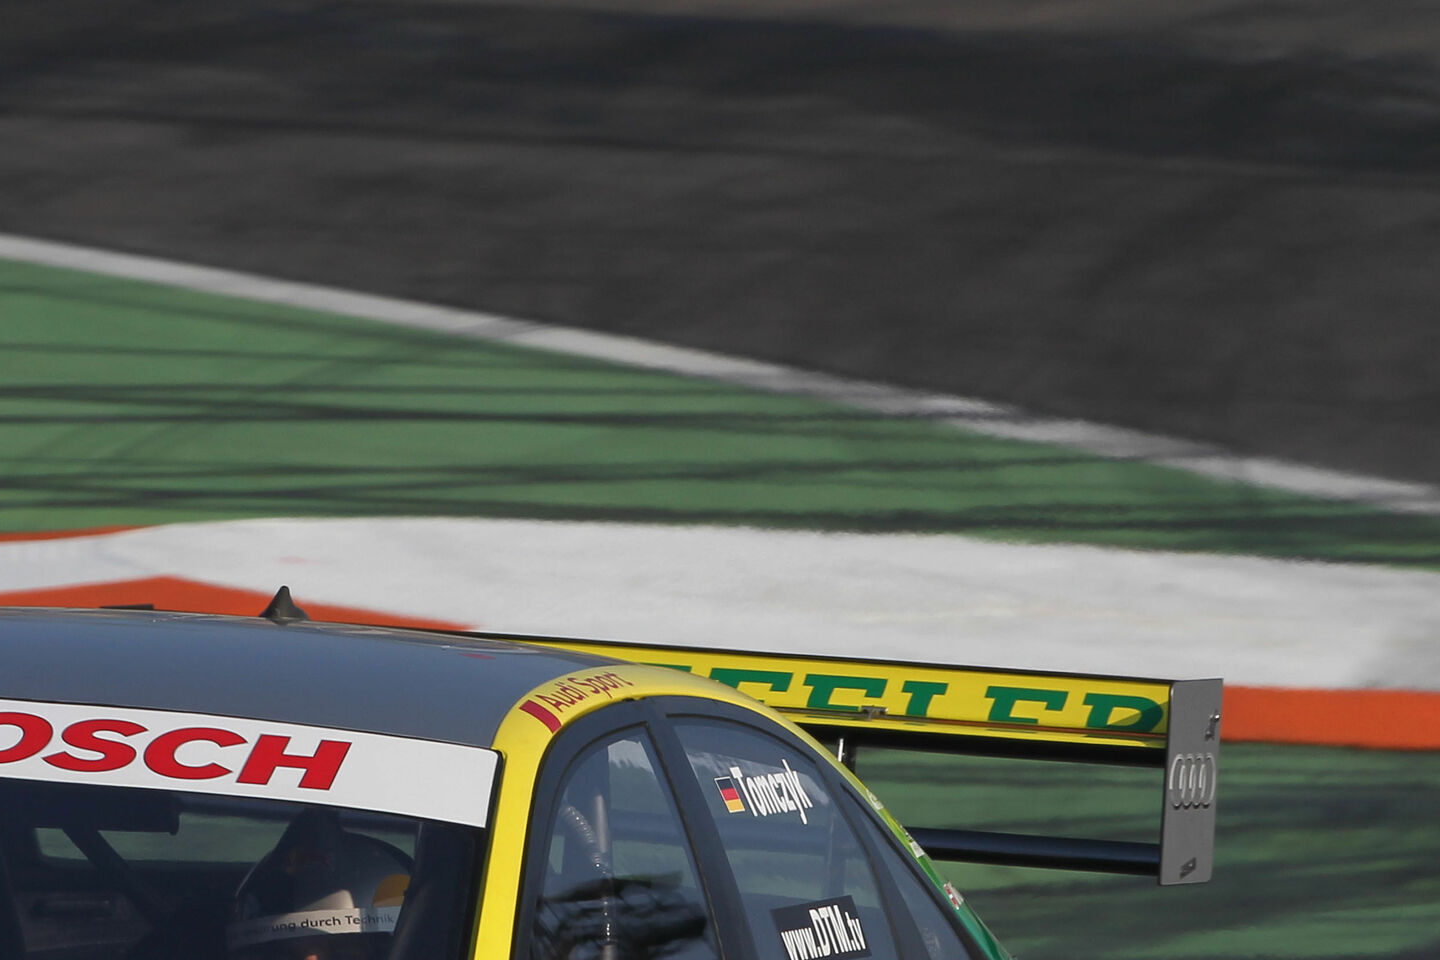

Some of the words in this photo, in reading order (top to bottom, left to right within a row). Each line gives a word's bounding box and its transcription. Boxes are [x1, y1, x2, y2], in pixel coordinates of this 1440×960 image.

[536, 681, 589, 713] Audi
[567, 671, 634, 700] Sport
[729, 758, 813, 825] Tomczyk
[300, 915, 342, 929] durch
[344, 914, 395, 926] Technik
